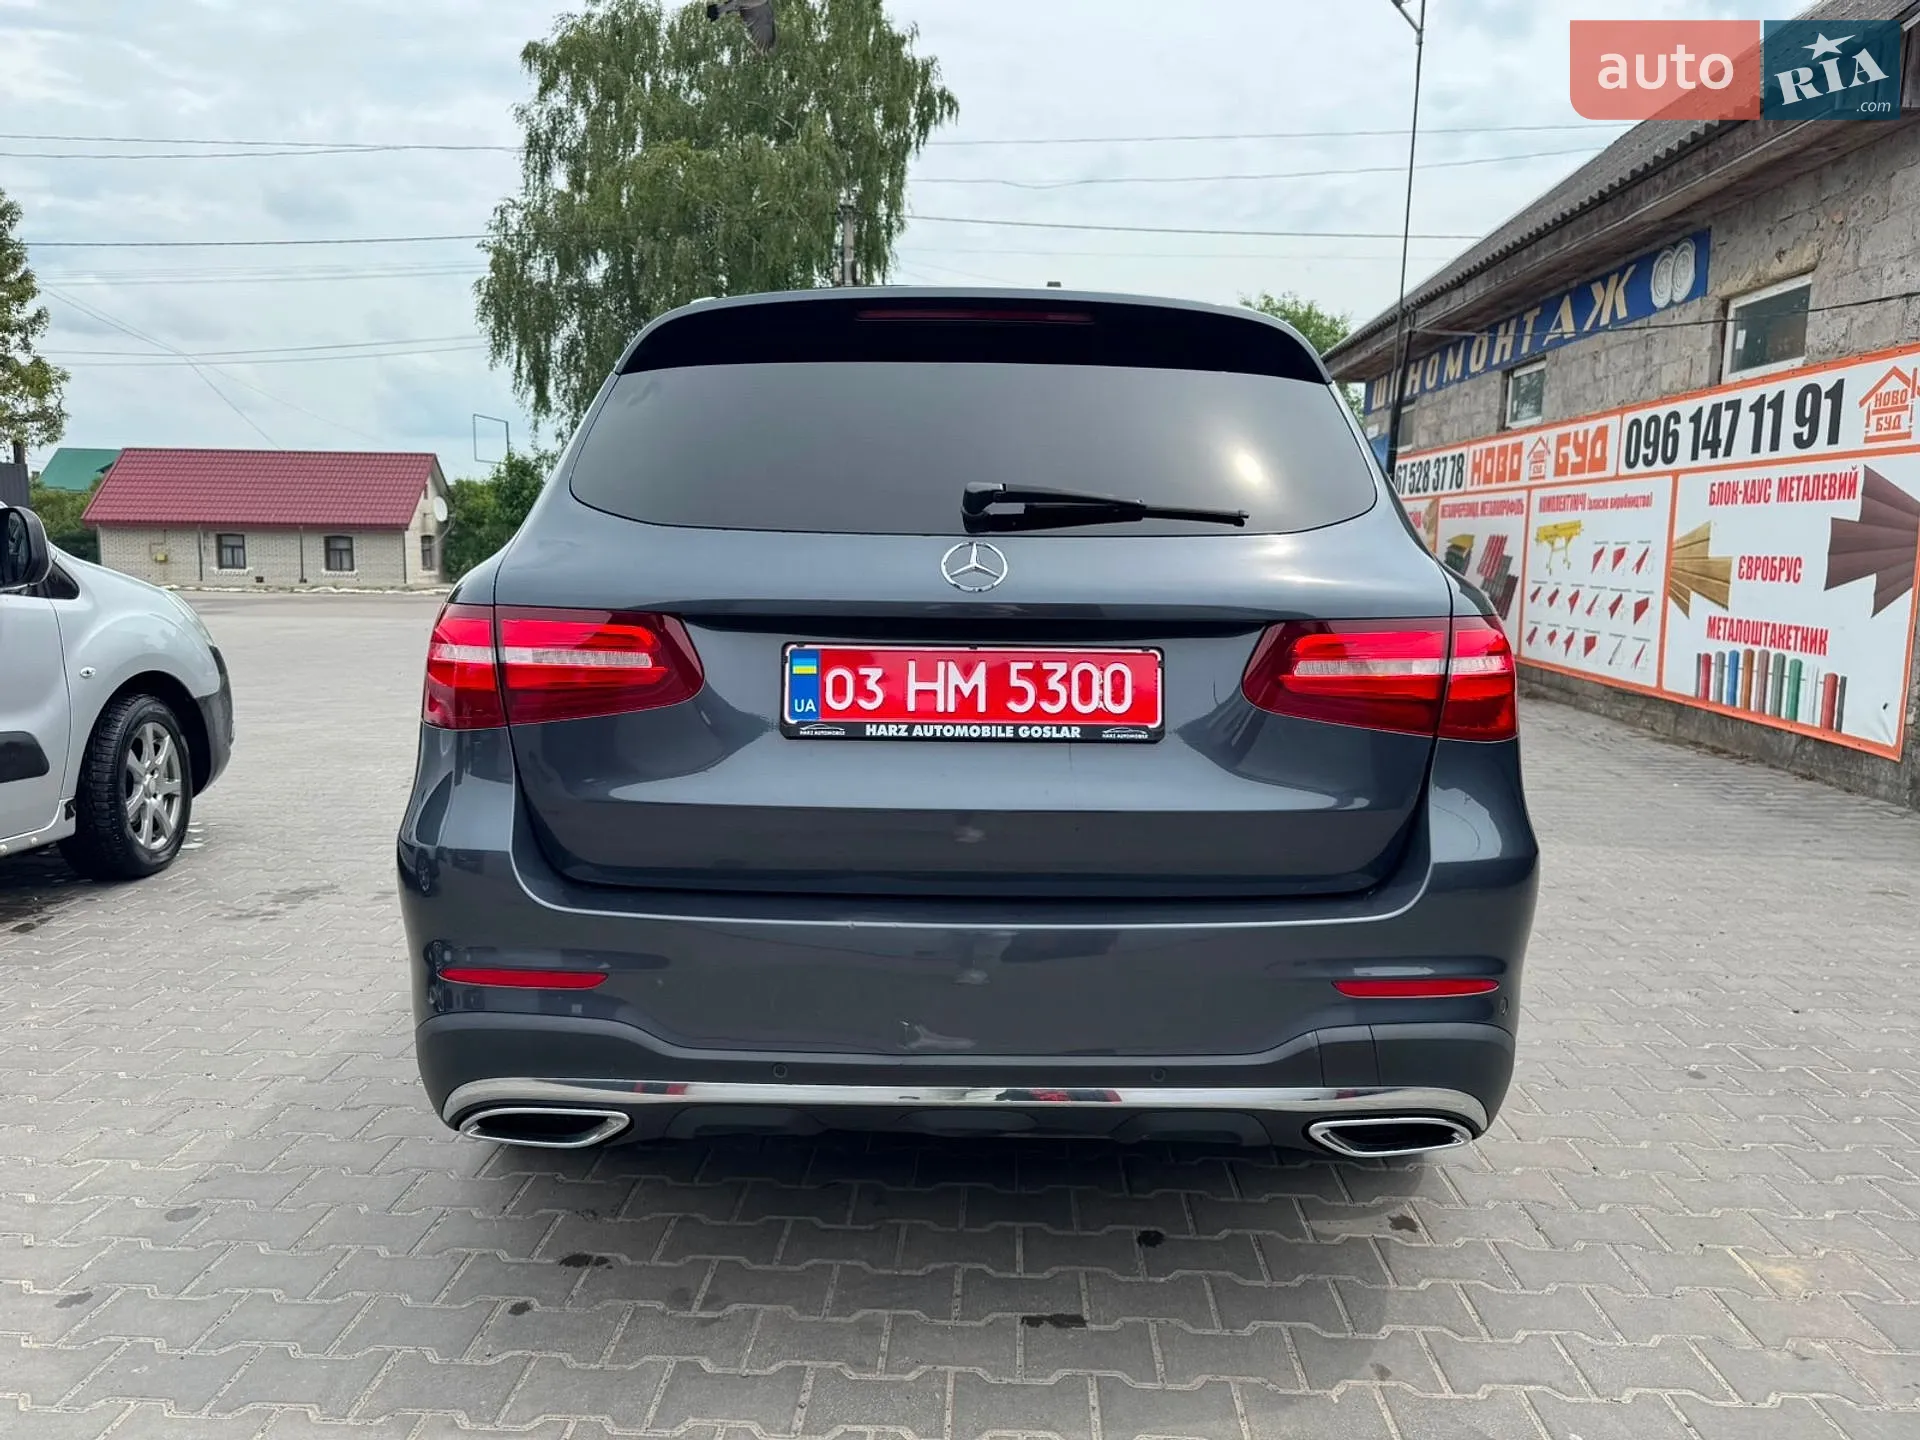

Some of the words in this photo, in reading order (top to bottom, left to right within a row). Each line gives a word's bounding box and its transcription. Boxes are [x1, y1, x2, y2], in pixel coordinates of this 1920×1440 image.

[1371, 264, 1636, 410] ШИНОМОНТАЖ
[1874, 388, 1908, 408] НОВО
[1624, 410, 1681, 469] 096
[1689, 399, 1742, 461] 147
[1749, 390, 1785, 454] 11
[1793, 378, 1845, 449] 91
[1875, 415, 1901, 432] БУД
[1470, 441, 1523, 486] НОВО
[1554, 424, 1609, 477] БУД
[1408, 459, 1431, 494] 528
[1708, 477, 1772, 506] БЛОК-ХАУС
[1776, 465, 1859, 503] МЕТАЛЕВИЙ
[1738, 555, 1803, 584] ЄВРОБРУС
[1706, 616, 1829, 656] МЕТАЛОШТАКЕТНИК
[794, 699, 816, 712] UA
[825, 667, 884, 711] 03
[907, 661, 986, 713] HM
[1006, 662, 1133, 714] 5300
[865, 724, 908, 737] HARZ
[912, 725, 1014, 738] AUTOMOBILE
[1018, 726, 1081, 738] GOSLAR
